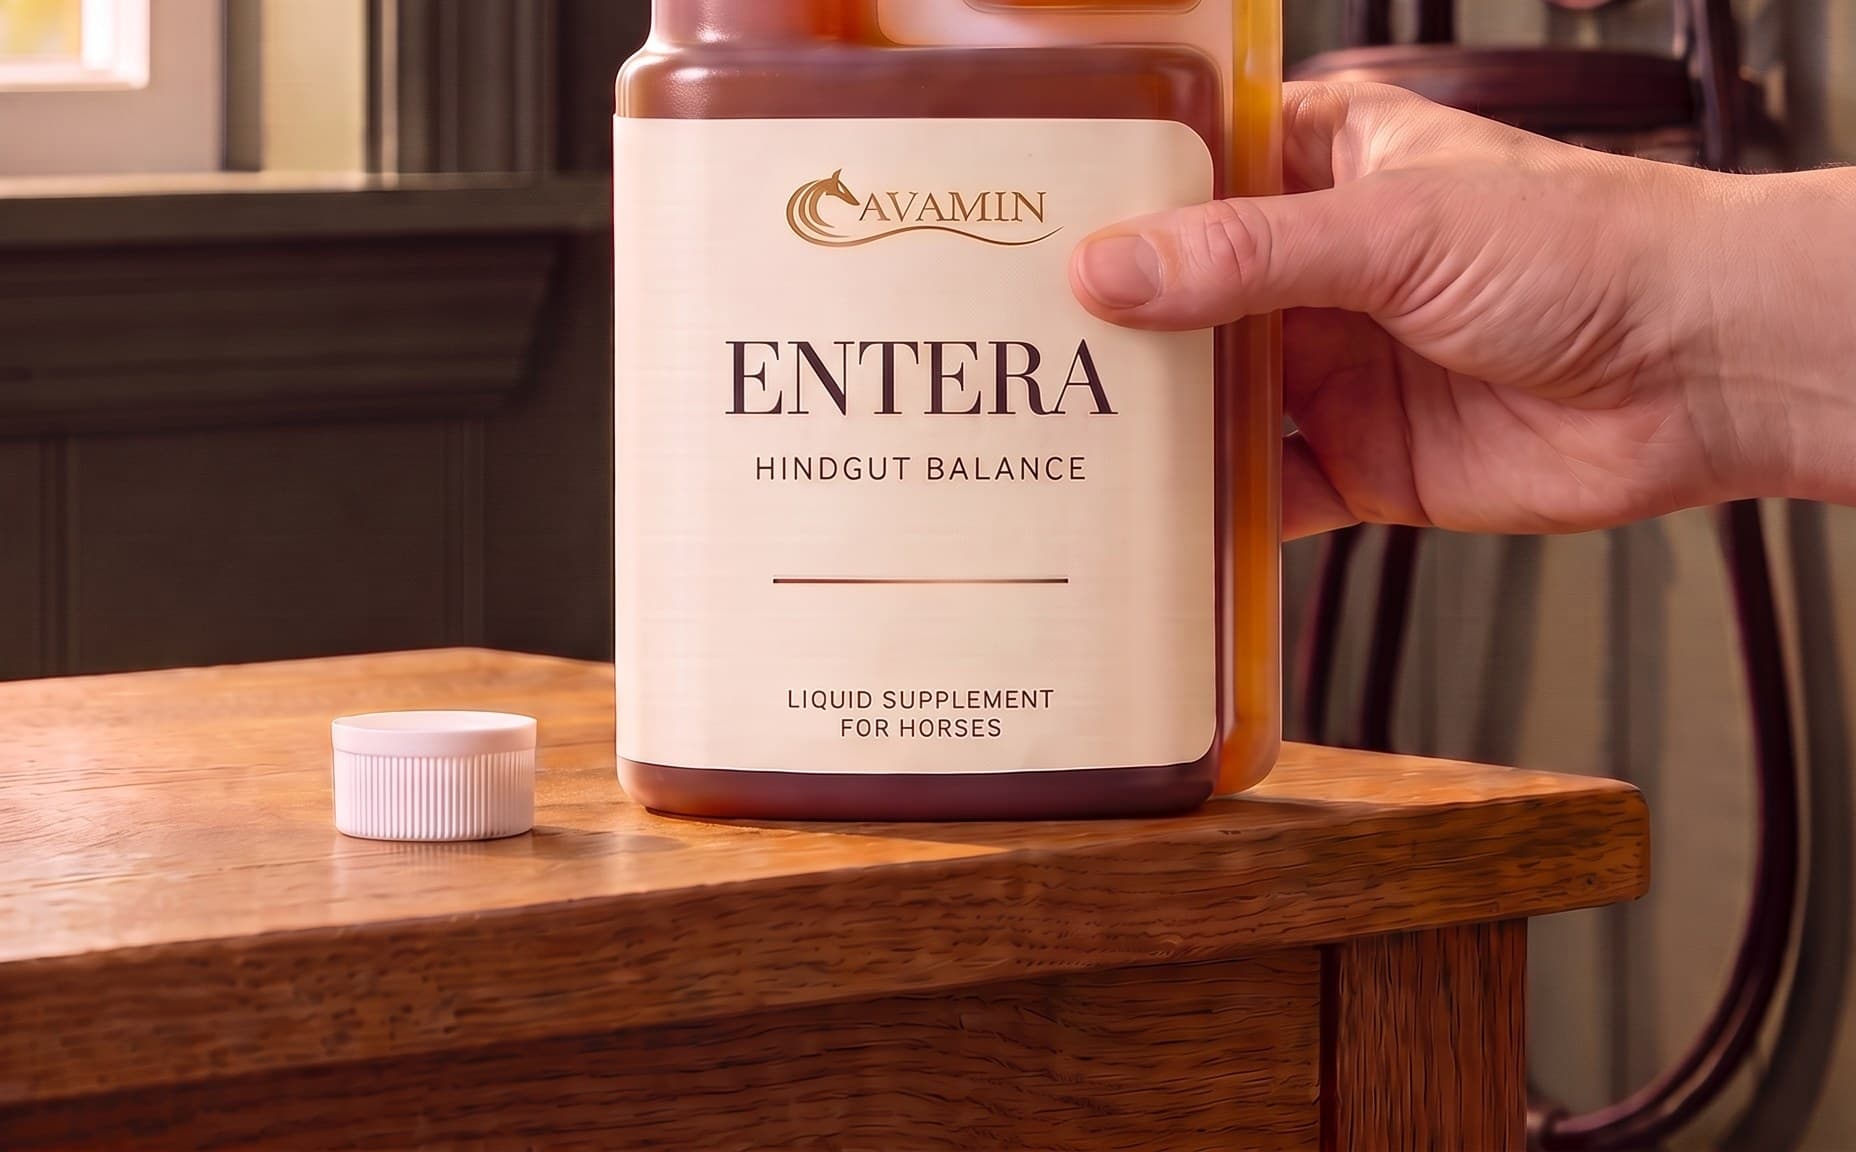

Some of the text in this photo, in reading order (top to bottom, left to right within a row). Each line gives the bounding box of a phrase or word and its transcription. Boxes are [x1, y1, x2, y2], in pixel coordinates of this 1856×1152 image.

[859, 191, 1047, 224] AVAMIN
[724, 338, 1119, 416] ENTERA
[756, 456, 1087, 481] HINDGUT BALANCE
[788, 689, 1055, 711] LIQUID SUPPLEMENT
[841, 718, 1002, 738] FOR HORSES
